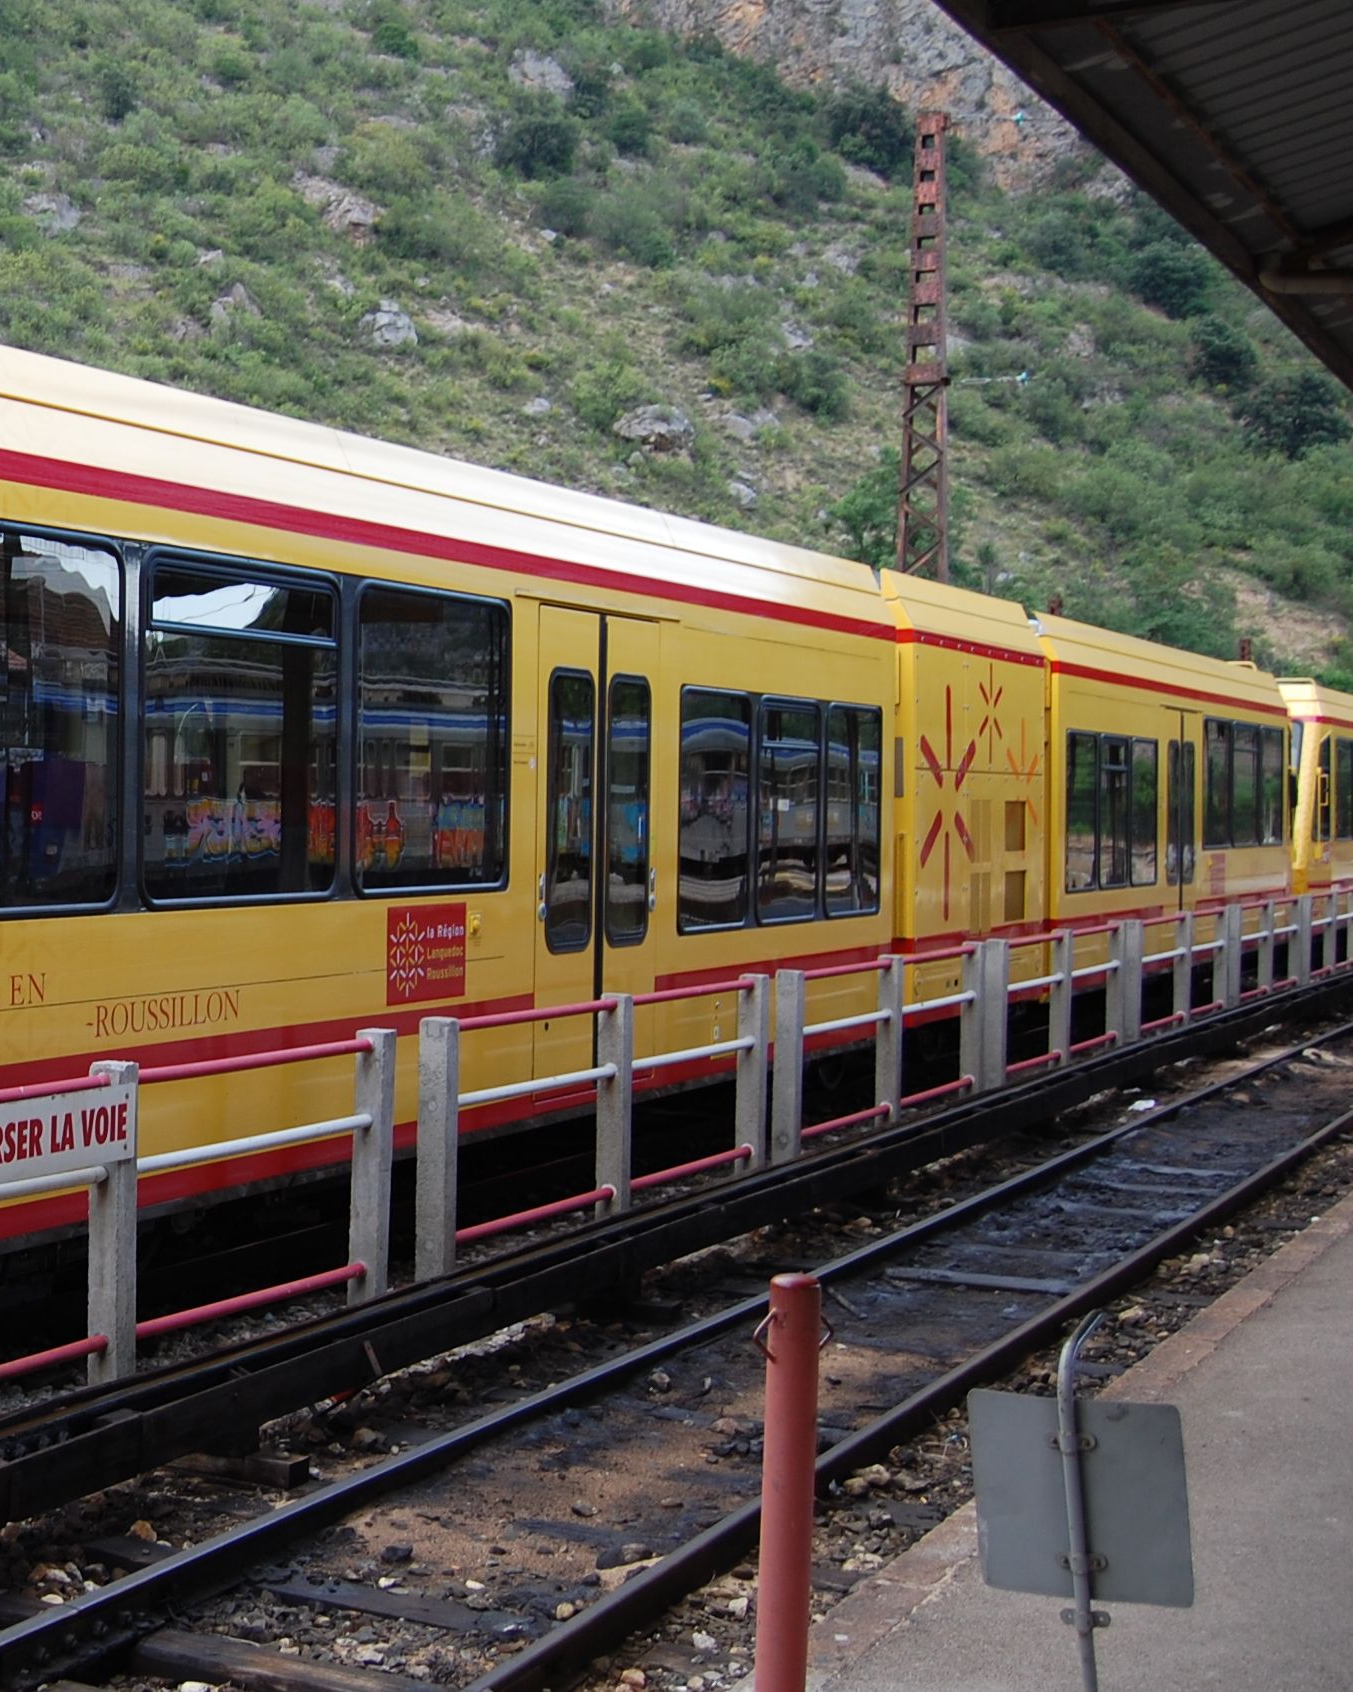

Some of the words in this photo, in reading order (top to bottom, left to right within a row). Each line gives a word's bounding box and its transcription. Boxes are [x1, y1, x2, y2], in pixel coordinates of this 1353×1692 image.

[9, 972, 47, 1006] EN
[50, 1113, 76, 1153] LA
[81, 1103, 128, 1146] VOIE
